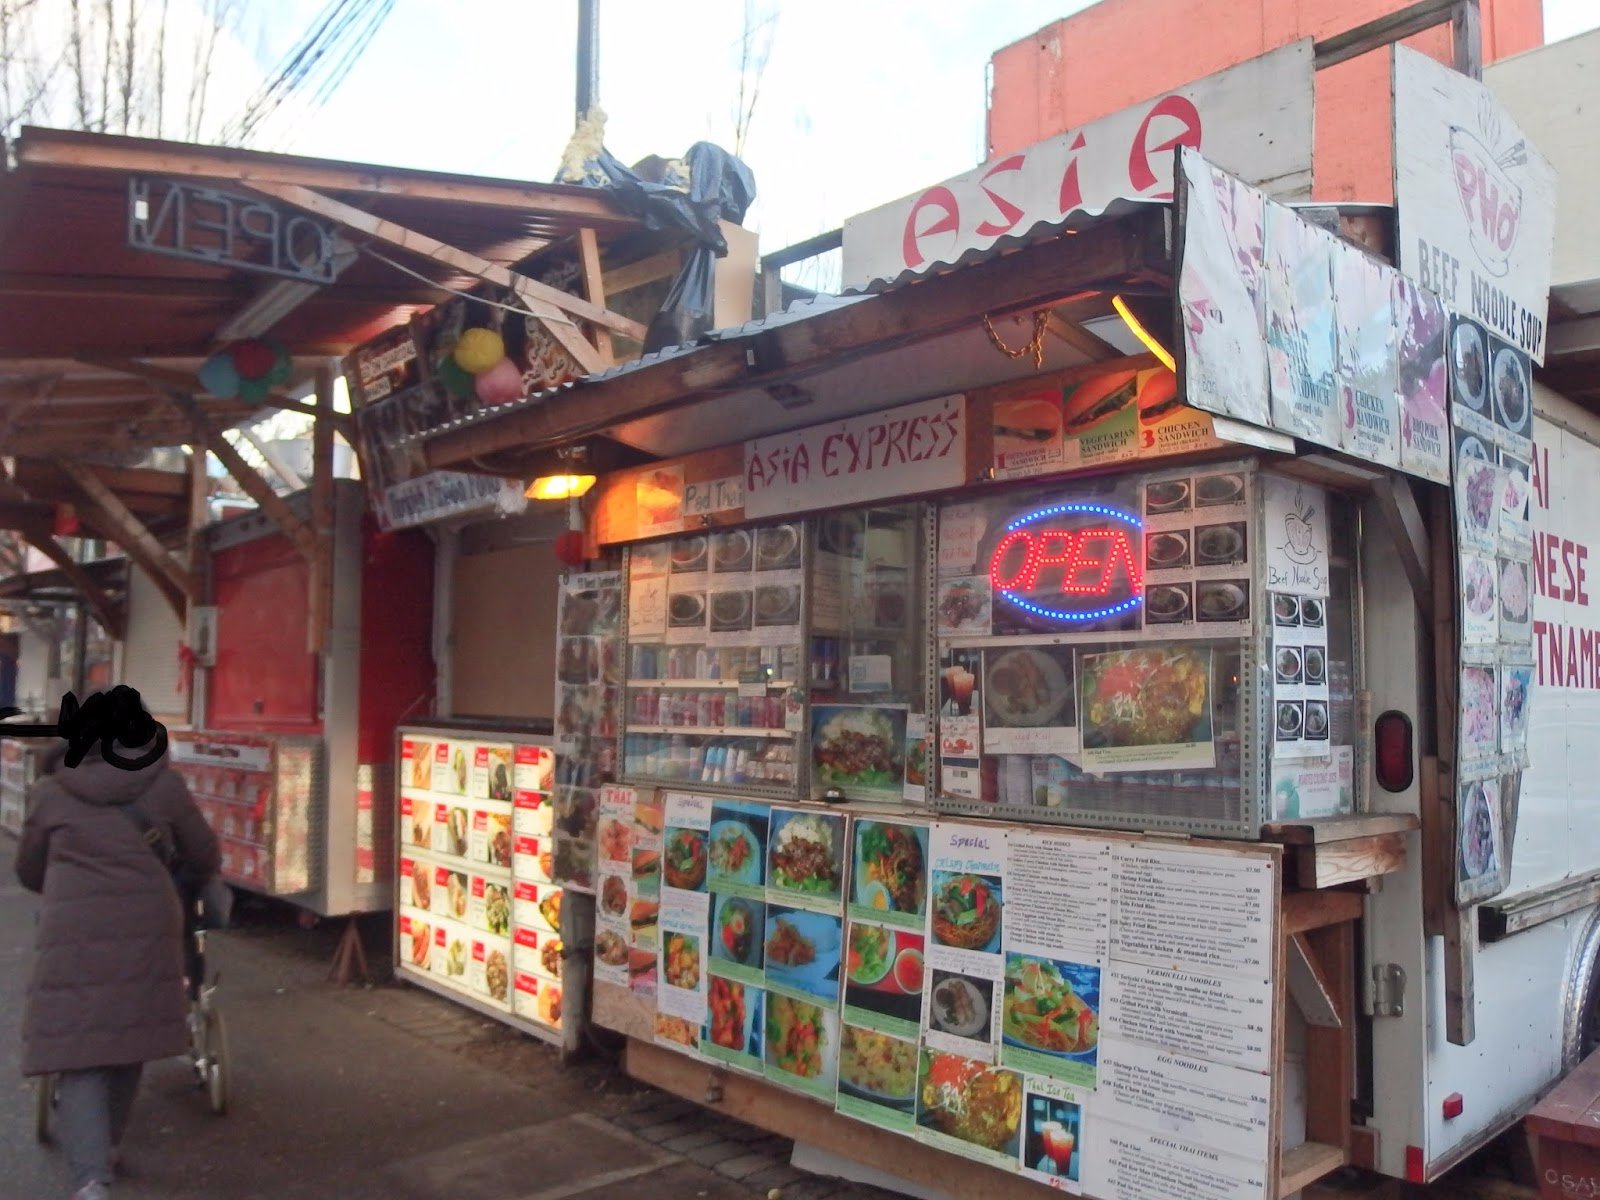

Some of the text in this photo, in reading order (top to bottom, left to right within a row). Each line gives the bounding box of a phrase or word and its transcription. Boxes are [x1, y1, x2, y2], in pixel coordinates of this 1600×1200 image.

[1419, 238, 1543, 355] BEEF NOODLE SOUP
[1291, 381, 1330, 406] NDWICH
[1356, 391, 1384, 413] CHICKEN
[1344, 386, 1355, 428] 3
[1157, 420, 1201, 435] CHICKEN
[1356, 409, 1390, 435] SANDWICH
[1403, 410, 1412, 448] 4
[822, 410, 959, 476] EXPRESS
[1080, 428, 1136, 446] VEGETARIAN
[1141, 430, 1156, 448] 3
[1158, 428, 1209, 443] SANDWICH
[1414, 434, 1441, 458] SANDWICH
[1081, 439, 1128, 454] SANDWICH
[685, 486, 711, 512] Pad
[990, 530, 1143, 595] OPEN
[1269, 566, 1288, 586] Beef
[950, 834, 990, 850] Special
[1121, 939, 1148, 949] Vegetables
[1150, 943, 1173, 953] Chicken
[1183, 948, 1206, 957] steamed
[1120, 974, 1139, 983] Teriyaki
[1140, 977, 1160, 987] Chicken
[1162, 980, 1172, 989] with
[1174, 982, 1182, 990] egg
[1184, 984, 1200, 993] noodle
[1209, 988, 1222, 997] fried
[1223, 990, 1233, 999] rice
[1146, 968, 1222, 987] VERMICELLI NOODLES
[1119, 998, 1136, 1008] Grilled
[1151, 1004, 1160, 1012] with
[1162, 1006, 1187, 1017] Vermicelli
[1118, 1017, 1137, 1027] Chicken
[1149, 1023, 1162, 1032] Fried
[1164, 1026, 1175, 1034] with
[1176, 1029, 1202, 1040] Vermicelli
[1113, 1061, 1132, 1071] Shrimp
[1133, 1065, 1148, 1075] Chow
[1150, 1069, 1163, 1078] Mein
[1157, 1055, 1208, 1073] EGG NOODLES
[1125, 1084, 1139, 1094] Chow
[1141, 1088, 1154, 1097] Mein
[1149, 1135, 1218, 1161] SPECIAL THAI ITEMS
